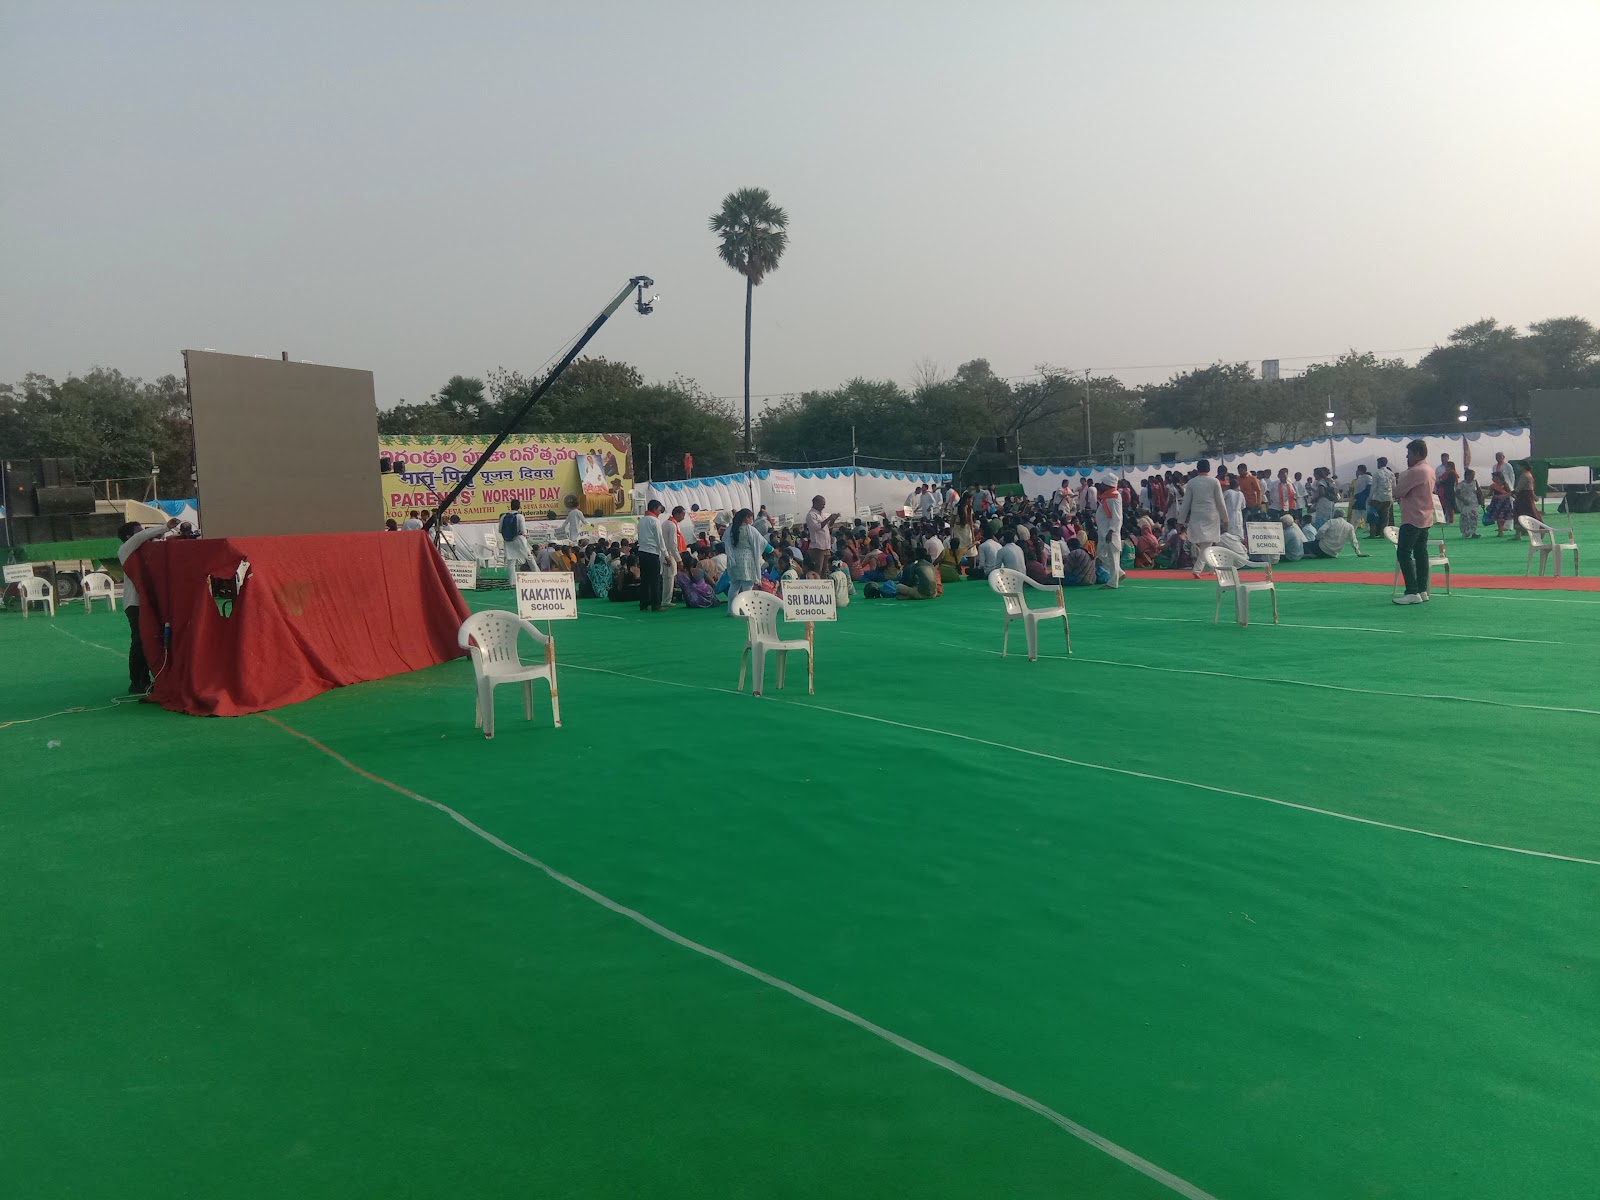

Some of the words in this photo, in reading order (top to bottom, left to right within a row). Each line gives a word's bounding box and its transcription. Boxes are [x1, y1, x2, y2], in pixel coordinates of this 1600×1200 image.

[480, 470, 513, 484] पूजन
[519, 466, 554, 479] दिवस
[482, 488, 536, 503] WORSHIP
[540, 487, 560, 500] DAY
[443, 508, 462, 516] SEVA
[463, 506, 495, 515] SAMITHI
[521, 588, 572, 601] KAKATIYA
[787, 594, 801, 605] SRI
[803, 594, 832, 605] BALAJI
[531, 603, 565, 611] SCHOOL
